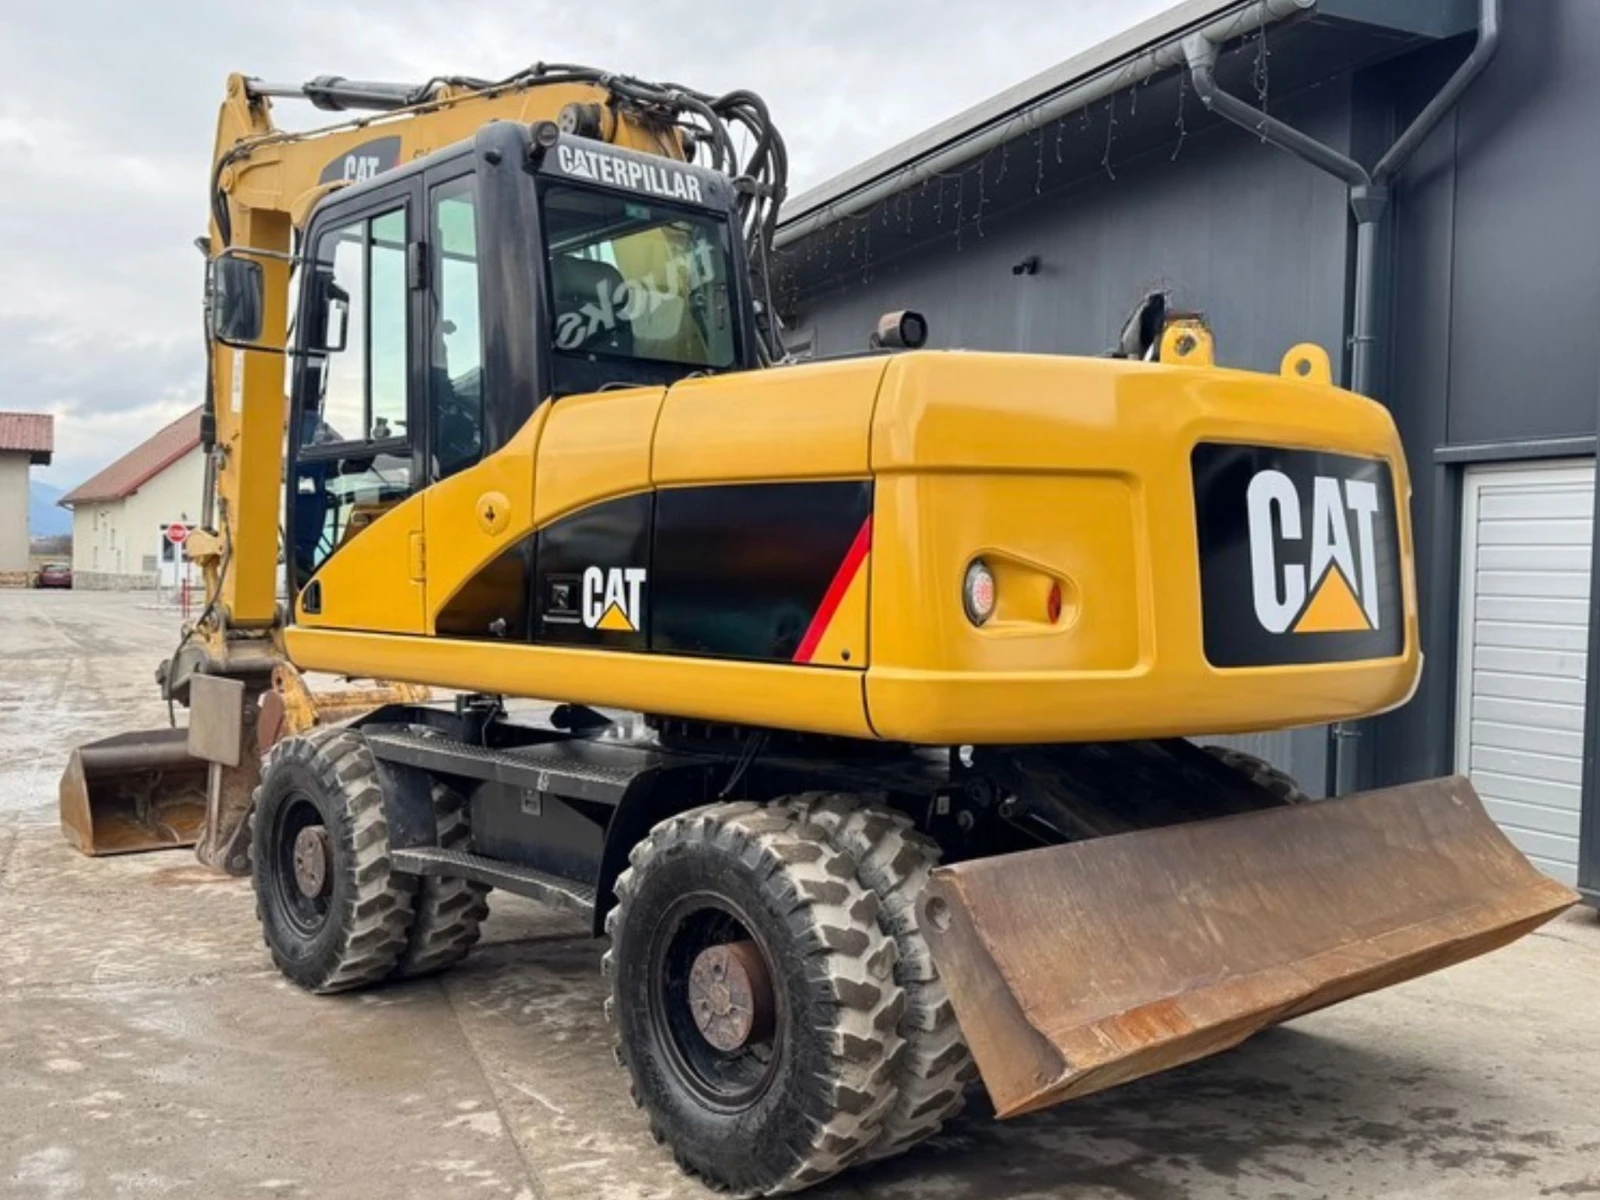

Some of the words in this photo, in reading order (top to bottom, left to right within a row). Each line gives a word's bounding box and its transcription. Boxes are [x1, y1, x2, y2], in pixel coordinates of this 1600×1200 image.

[557, 144, 703, 203] CATERPILLAR
[1246, 469, 1381, 635] CAT
[582, 565, 647, 632] CAT
